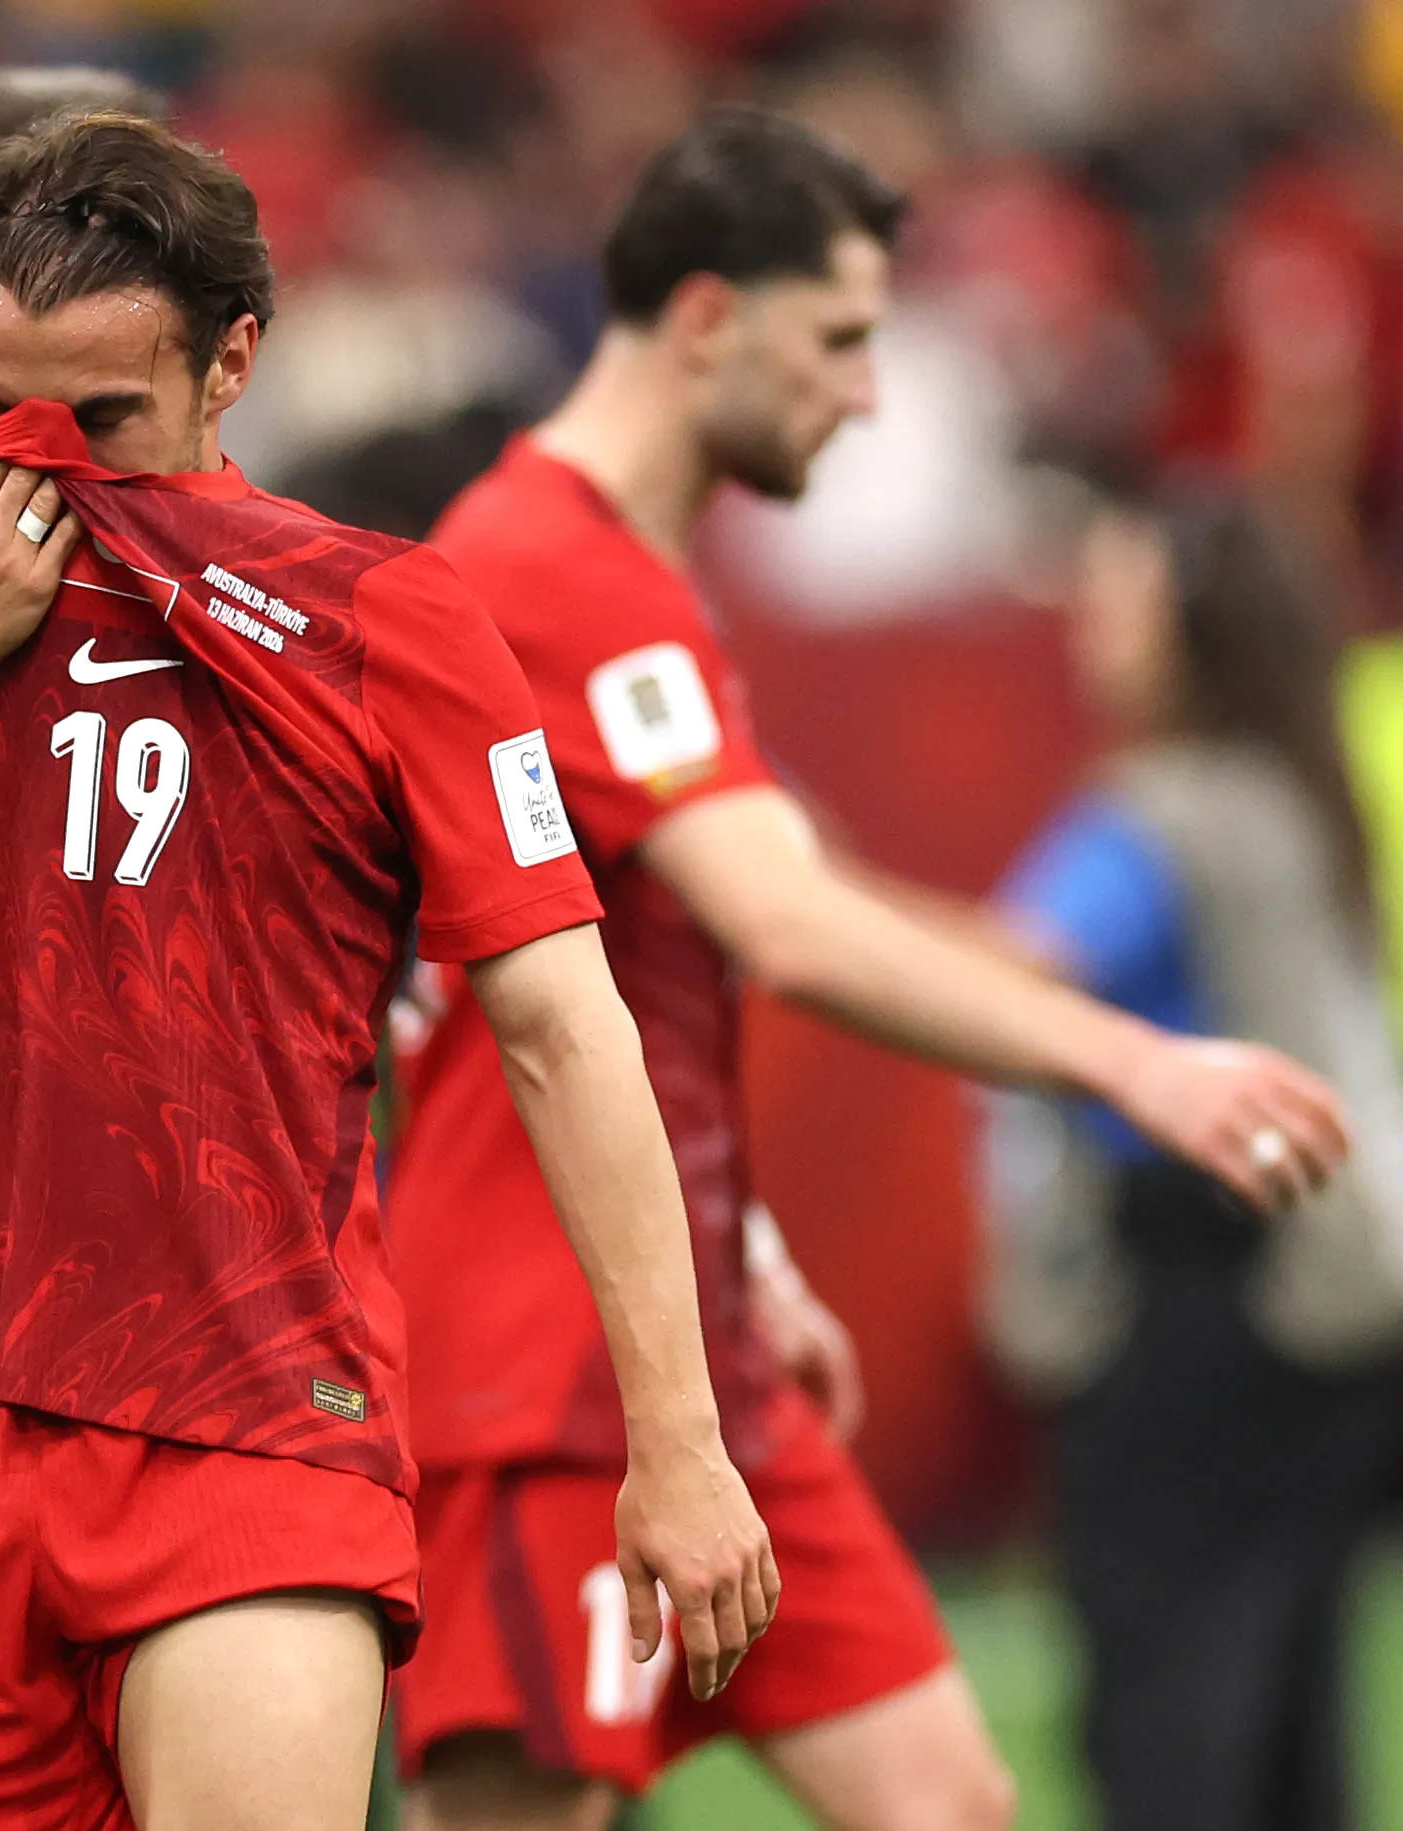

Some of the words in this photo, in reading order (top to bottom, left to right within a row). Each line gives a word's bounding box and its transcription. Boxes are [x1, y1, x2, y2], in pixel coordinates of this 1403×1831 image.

[200, 562, 310, 636] AVUSTRALYA-TÜRKİYE
[206, 597, 222, 619] 13
[217, 602, 264, 642] HAZİRAN
[258, 626, 284, 653] 2026
[50, 710, 190, 887] 19
